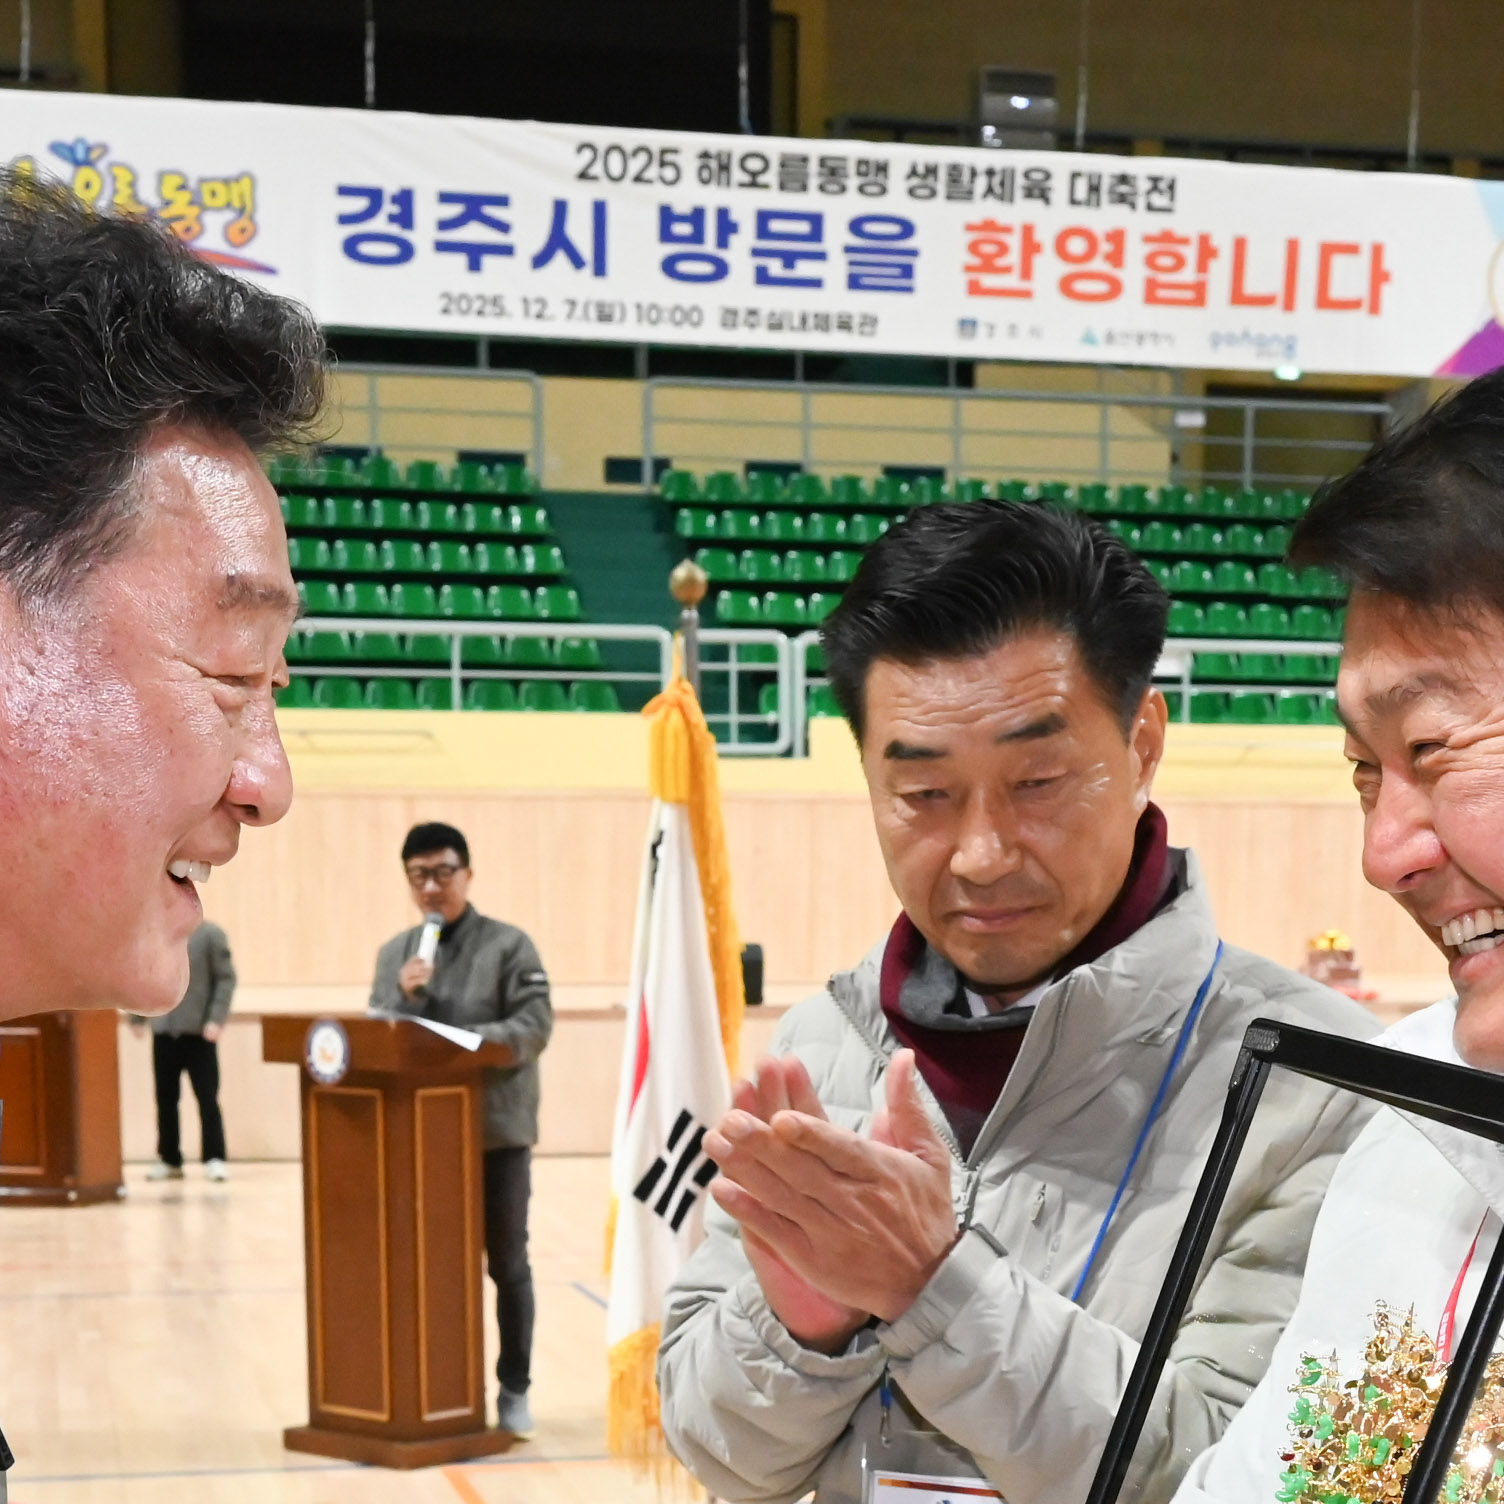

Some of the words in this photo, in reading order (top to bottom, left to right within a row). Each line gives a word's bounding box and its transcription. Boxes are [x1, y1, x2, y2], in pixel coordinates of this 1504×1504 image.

[574, 142, 682, 187] 2025
[696, 149, 890, 197] 해오름동맹
[905, 160, 1054, 206] 생활체육
[1069, 170, 1177, 214] 대축전
[336, 182, 610, 279] 경주시
[657, 197, 922, 296] 방문을
[962, 217, 1393, 318] 환영합니다
[438, 291, 513, 318] 2025.
[521, 296, 555, 321] 12.
[635, 302, 703, 328] 10:00
[718, 306, 880, 337] 경주실내체육관
